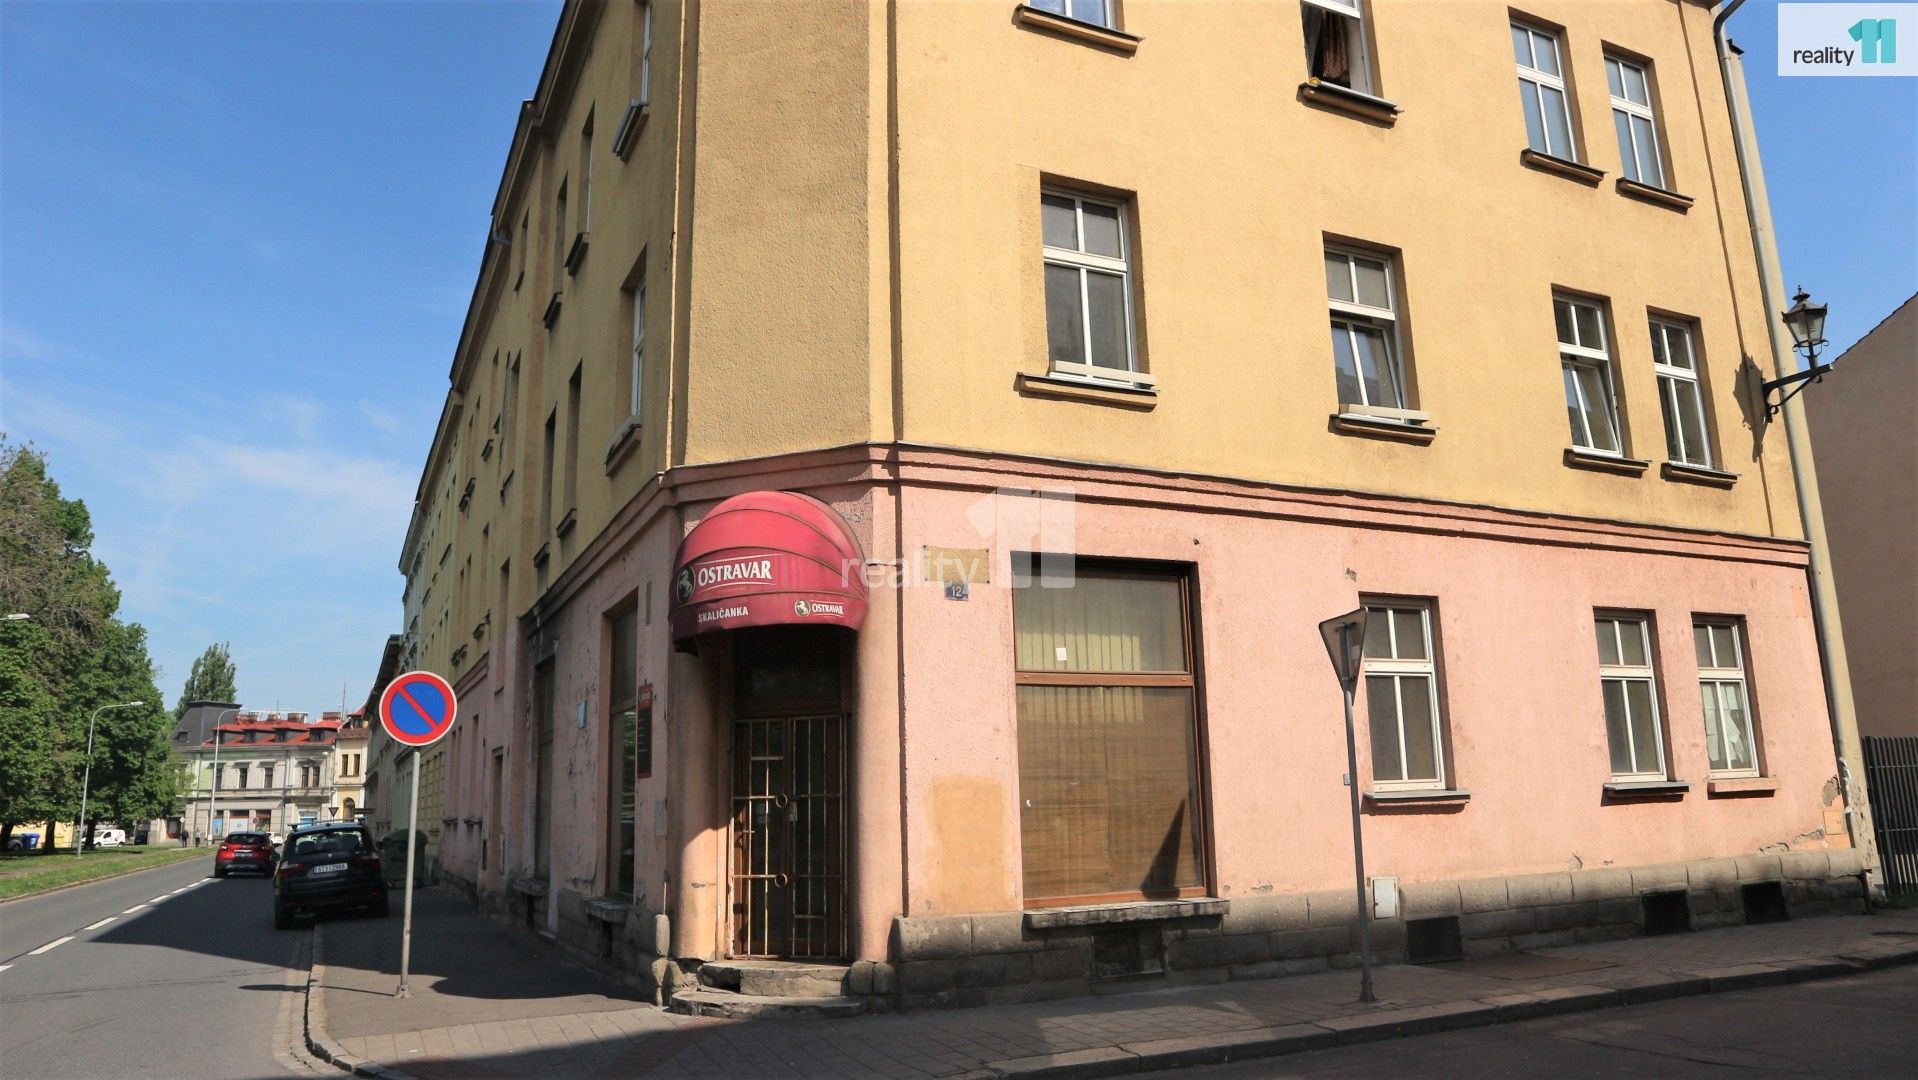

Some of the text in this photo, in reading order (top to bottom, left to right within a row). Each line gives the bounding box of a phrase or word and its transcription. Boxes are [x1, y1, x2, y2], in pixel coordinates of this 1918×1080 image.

[698, 560, 773, 586] OSTRAVAR
[698, 606, 749, 623] SKALIČANKA
[811, 602, 844, 615] OSTRAVAR
